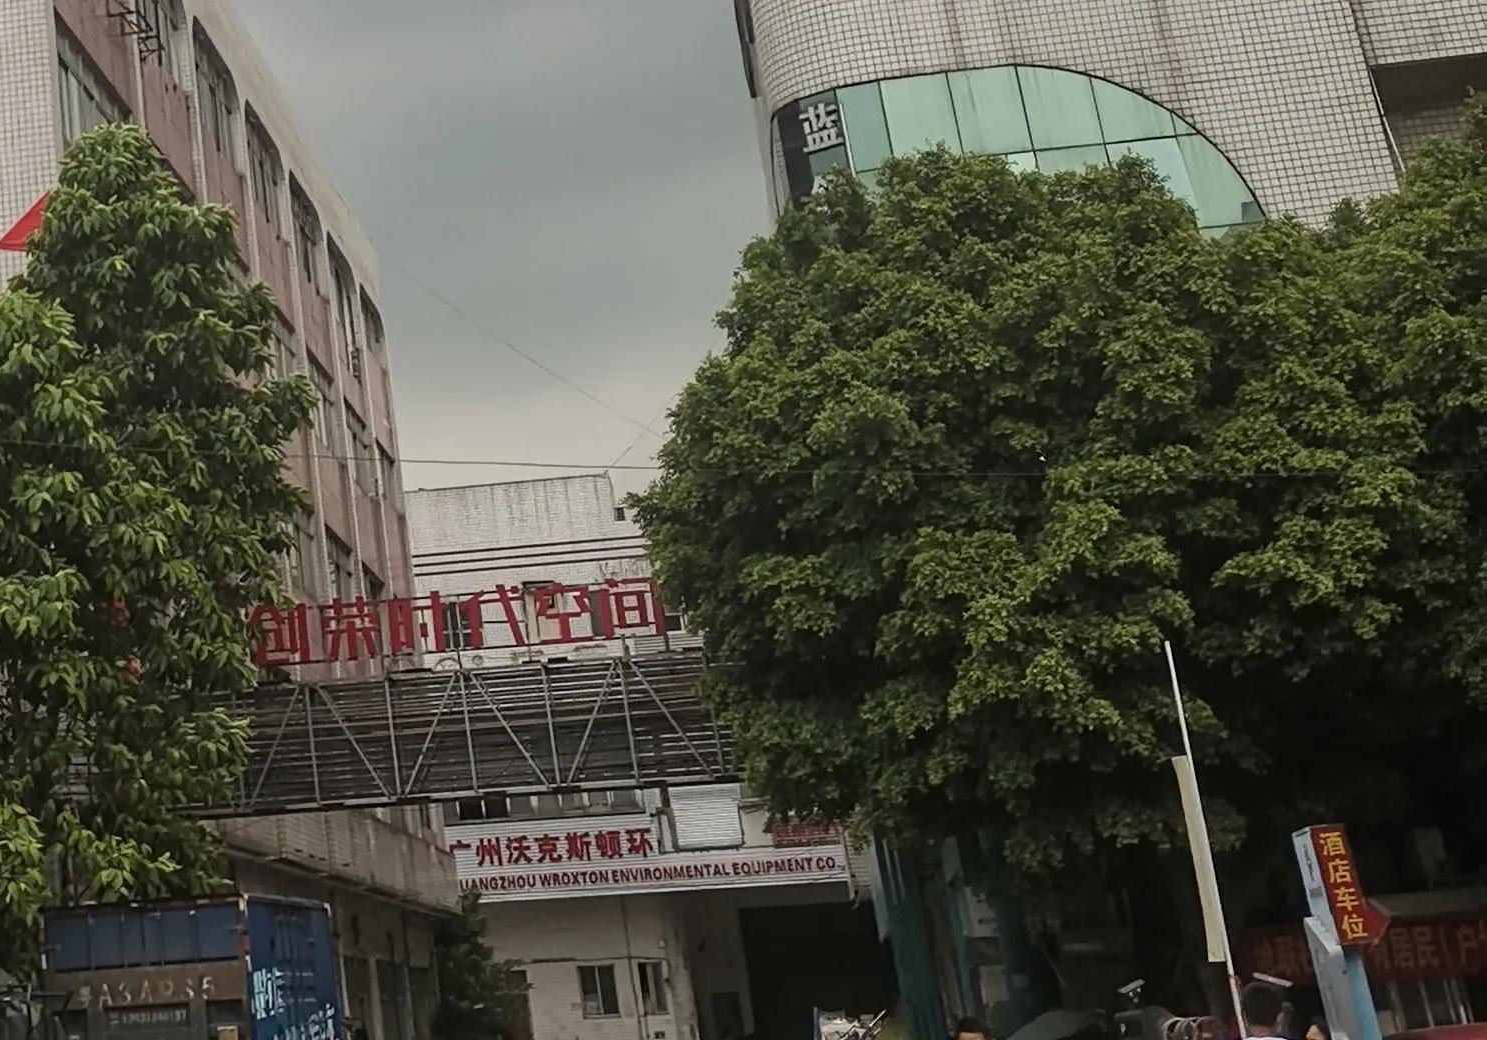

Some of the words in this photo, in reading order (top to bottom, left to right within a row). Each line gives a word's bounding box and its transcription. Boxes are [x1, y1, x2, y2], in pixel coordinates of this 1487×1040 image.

[246, 577, 666, 667] 创荣时代空间
[539, 869, 609, 888] WROXTON
[612, 863, 730, 883] ENVIRONMENTAL
[732, 858, 814, 876] EQUIPMENT
[1319, 831, 1369, 941] 酒店车位
